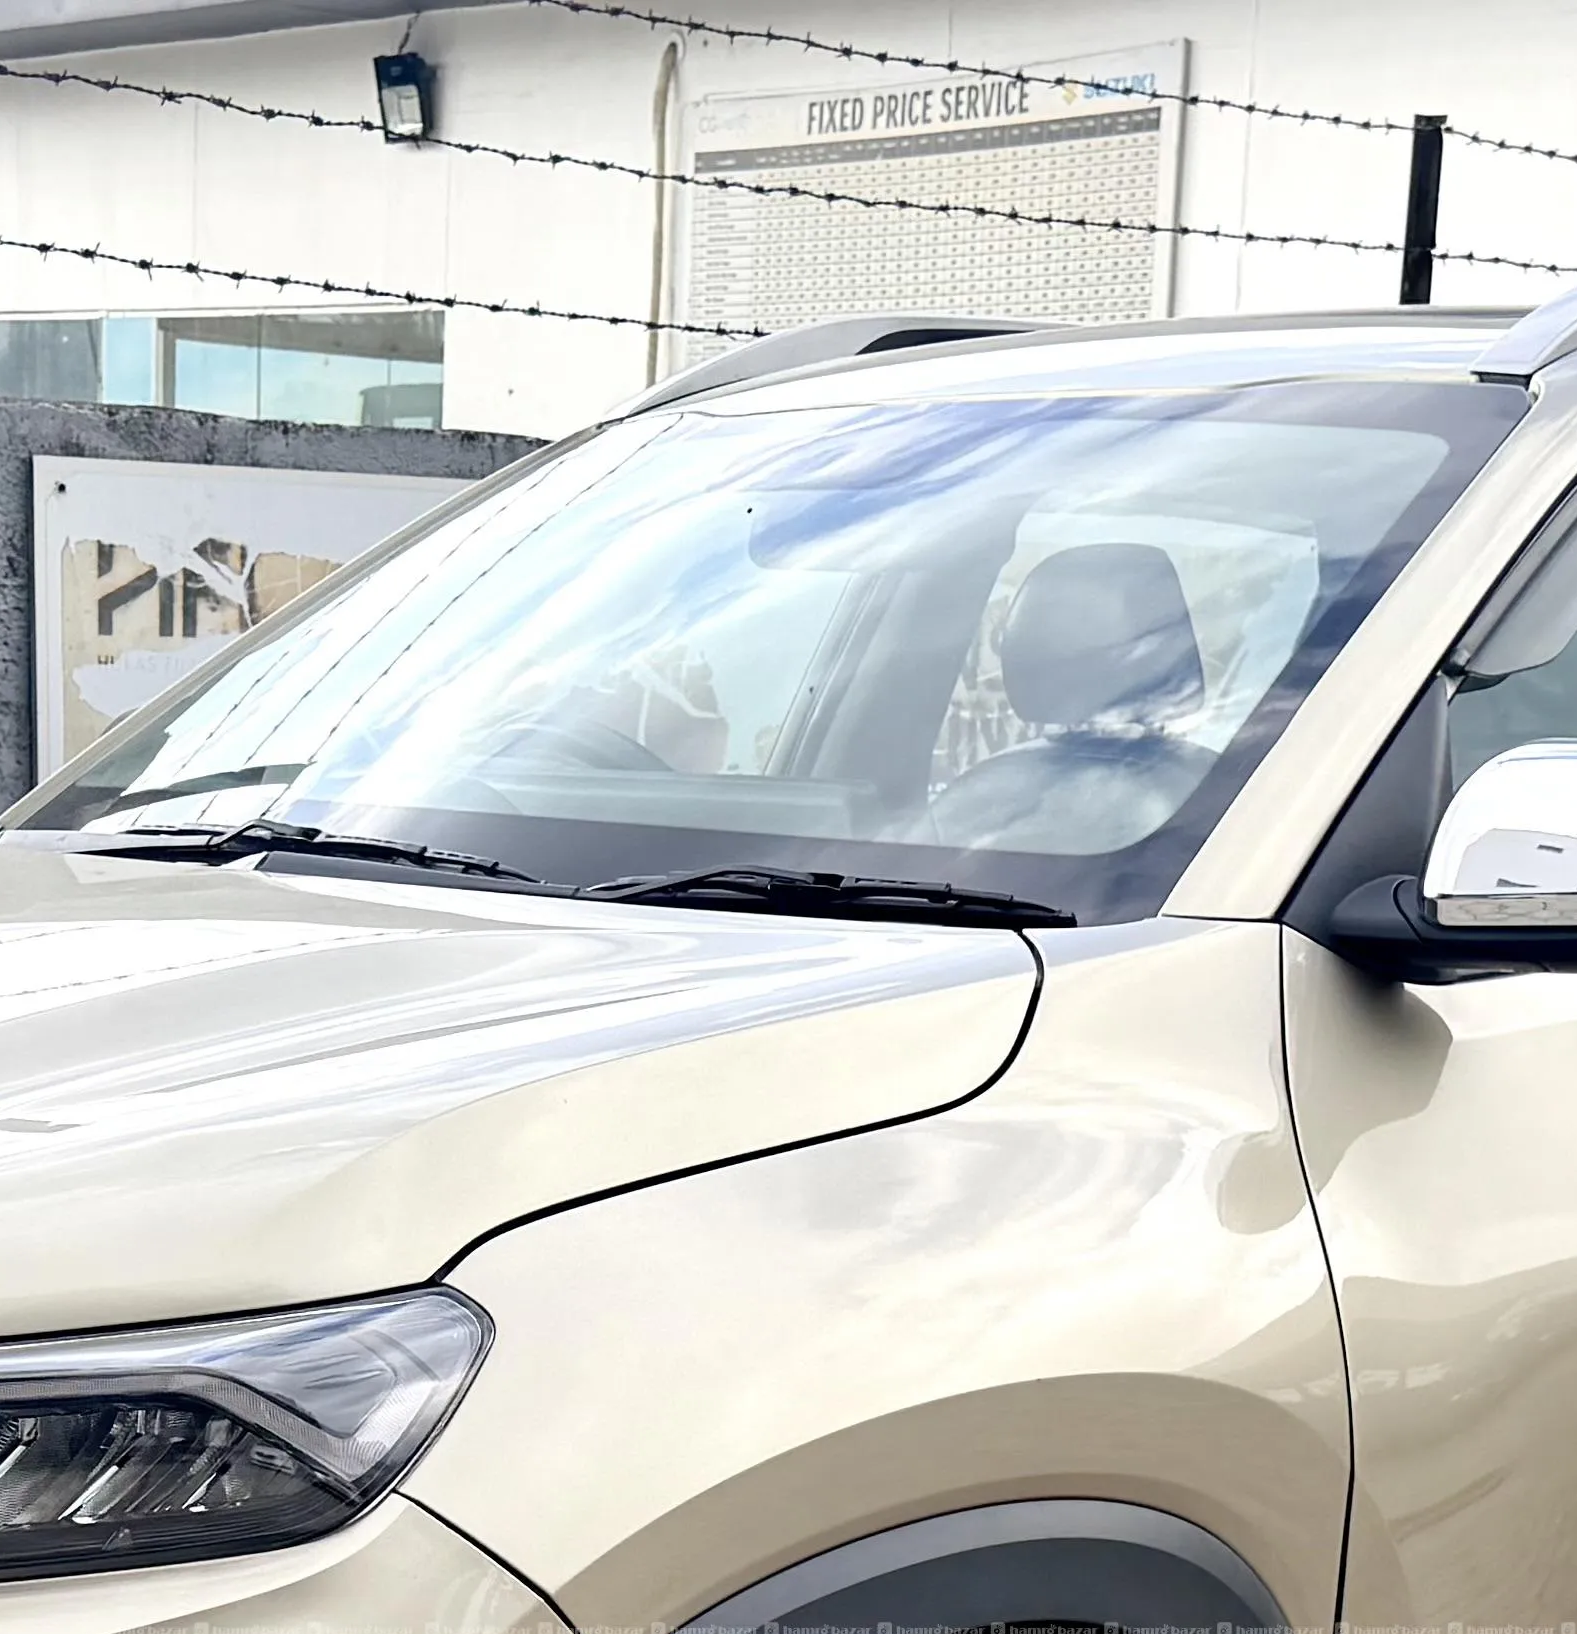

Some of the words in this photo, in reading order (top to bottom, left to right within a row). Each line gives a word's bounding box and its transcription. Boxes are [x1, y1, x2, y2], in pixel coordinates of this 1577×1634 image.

[807, 97, 864, 136] FIXED
[871, 90, 933, 130] PRICE
[940, 79, 1029, 123] SERVICE
